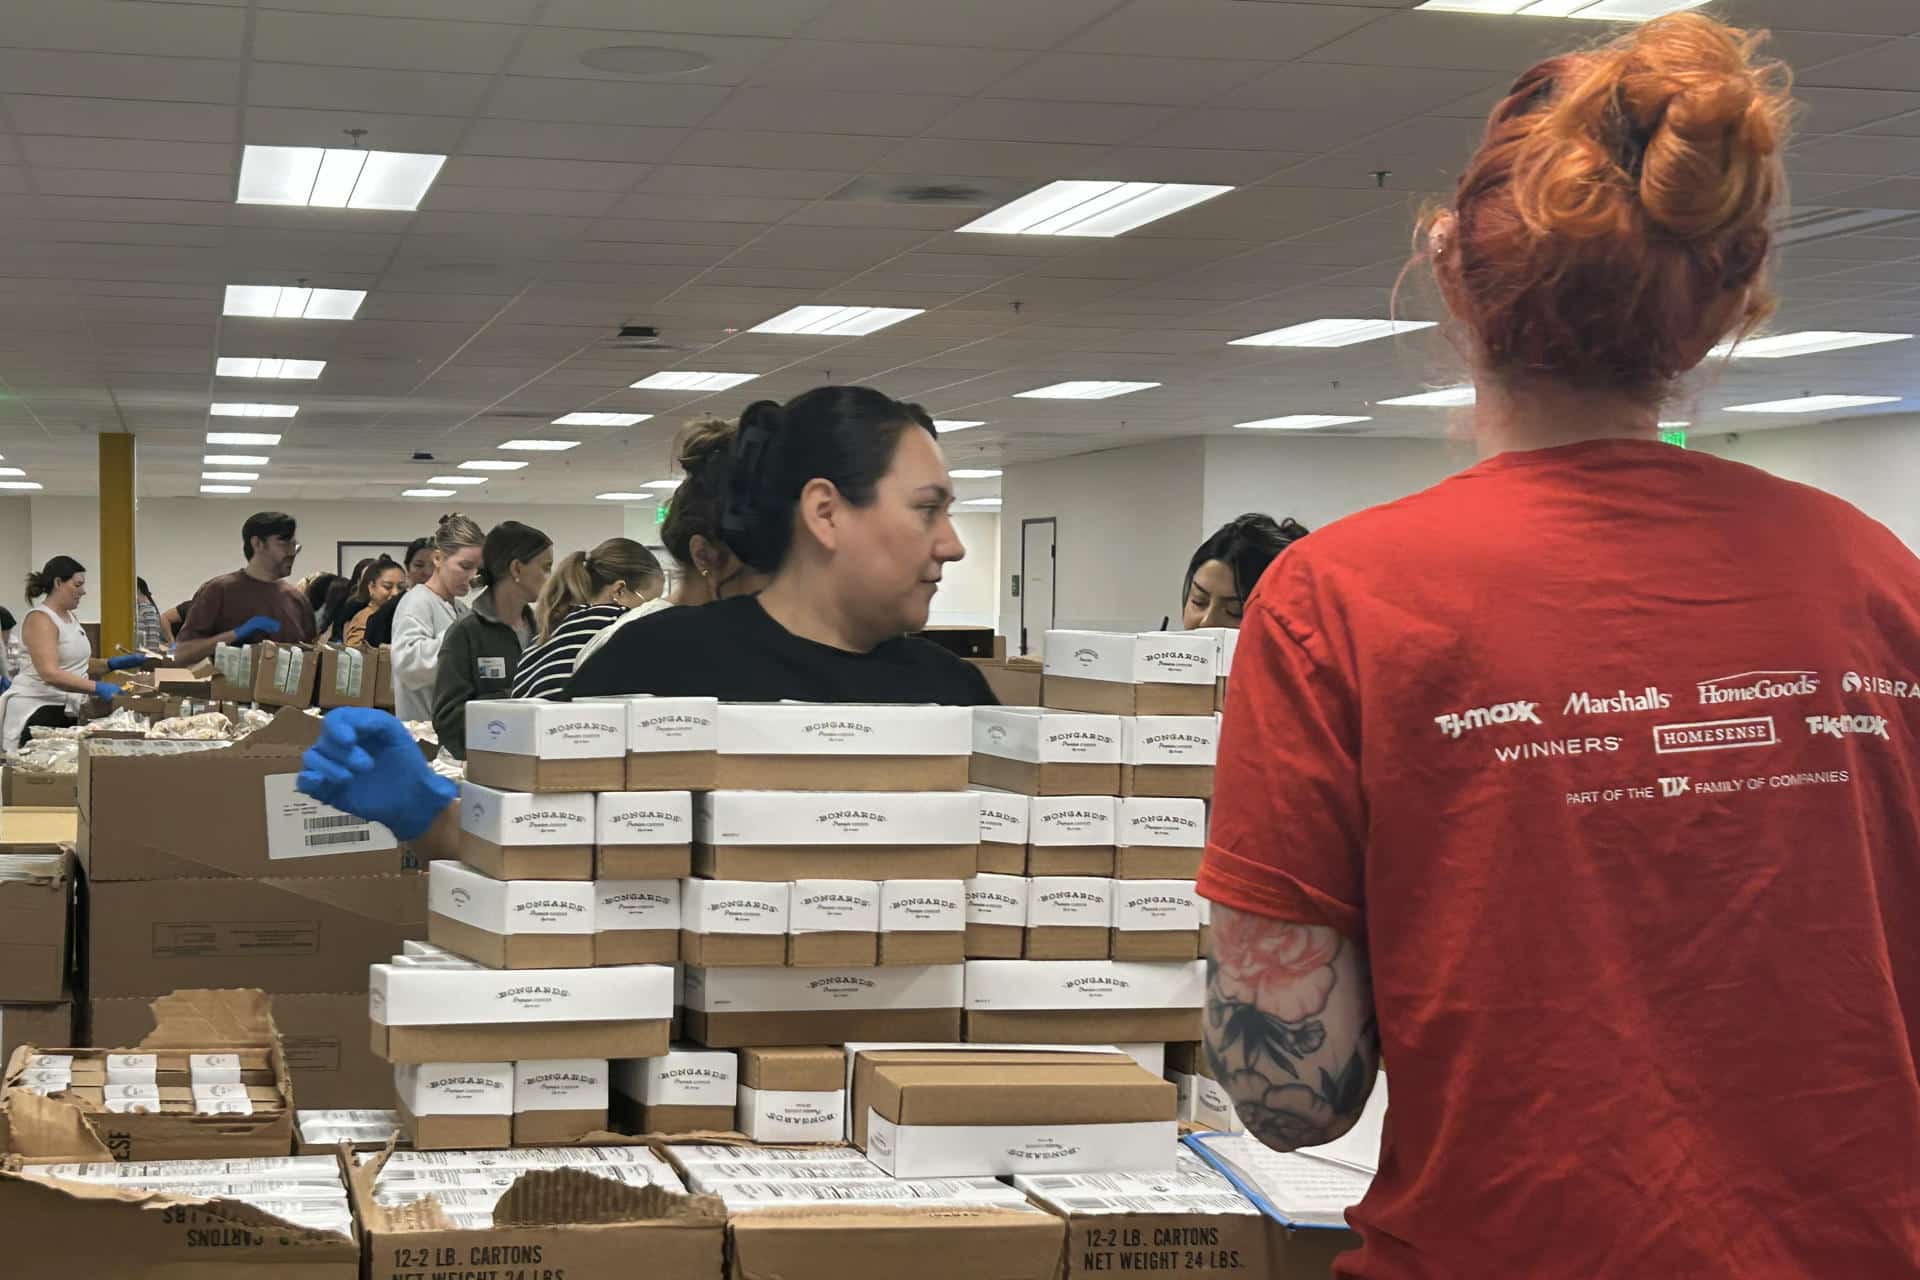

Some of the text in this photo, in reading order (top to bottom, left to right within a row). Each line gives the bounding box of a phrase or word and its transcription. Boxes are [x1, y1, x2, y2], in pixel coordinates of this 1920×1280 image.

[1698, 676, 1817, 704] HomeGoods
[1863, 676, 1920, 698] SIERRA
[1563, 687, 1672, 715] Marshalls
[1664, 726, 1767, 745] HOMESENSE
[1495, 737, 1620, 762] WINNERS
[1567, 791, 1599, 804] PART
[1603, 789, 1625, 801] OF
[1629, 787, 1654, 799] THE
[1695, 780, 1743, 794] FAMILY
[1747, 778, 1766, 790] OF
[1769, 771, 1849, 788] COMPANIES
[1087, 1230, 1116, 1247] 12-2
[1153, 1229, 1218, 1247] CARTONS
[394, 1249, 428, 1268] 12-2
[470, 1246, 542, 1264] CARTONS
[1084, 1252, 1113, 1271] NET
[1120, 1252, 1180, 1270] WEIGHT
[1184, 1251, 1204, 1269] 24
